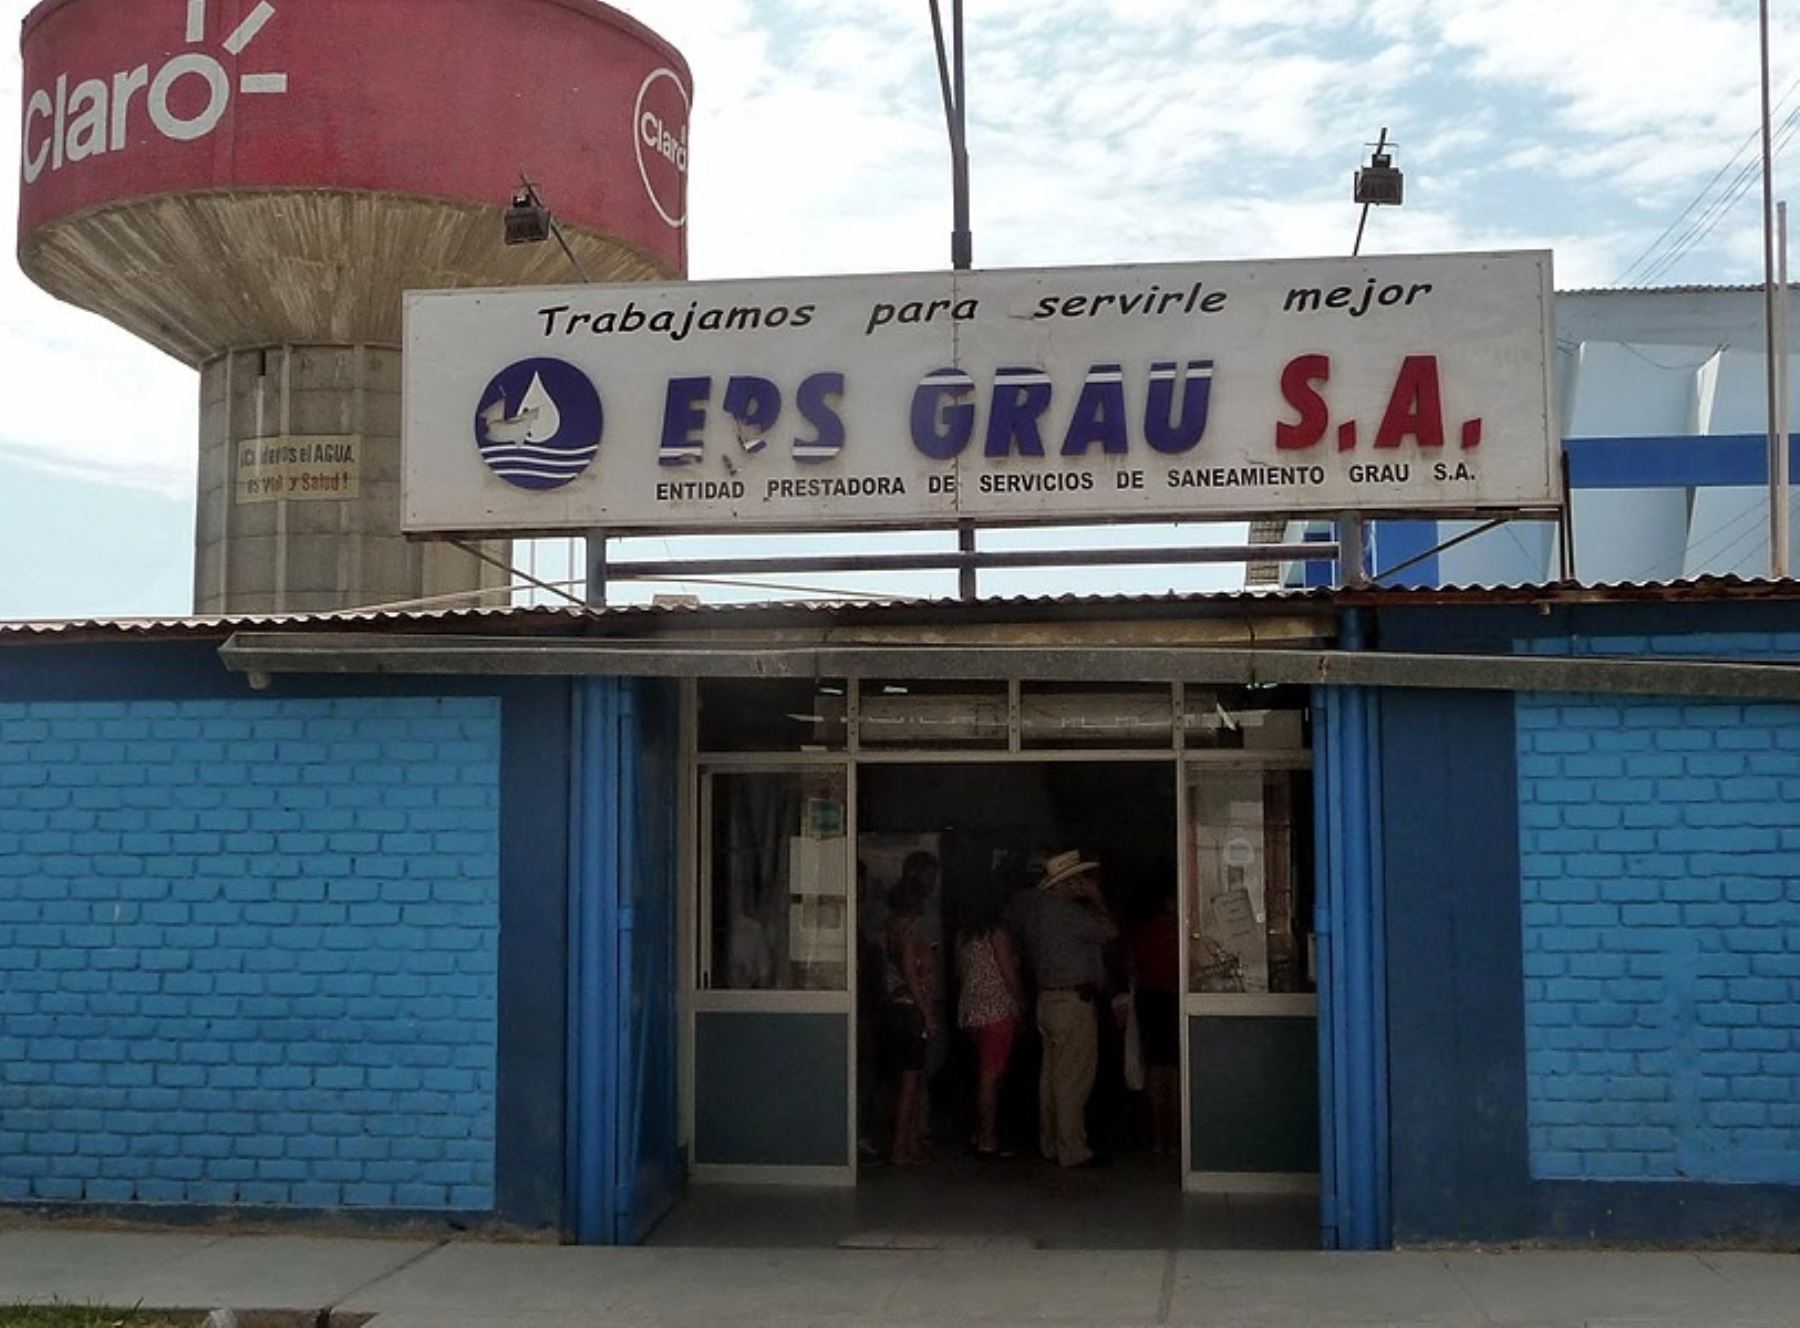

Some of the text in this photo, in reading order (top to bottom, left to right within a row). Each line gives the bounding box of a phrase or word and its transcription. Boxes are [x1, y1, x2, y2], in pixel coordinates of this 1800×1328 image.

[23, 53, 230, 184] Claro
[640, 112, 686, 171] Claro
[537, 277, 1433, 341] Trabajamos para servirle mejor
[658, 353, 1482, 467] EPS GRAU S.A.
[313, 443, 355, 463] AGUA
[656, 463, 1476, 501] ENTIDAD PRESTADORA DE SERVICIOS DE SANEAMIENTO GRAU S.A.
